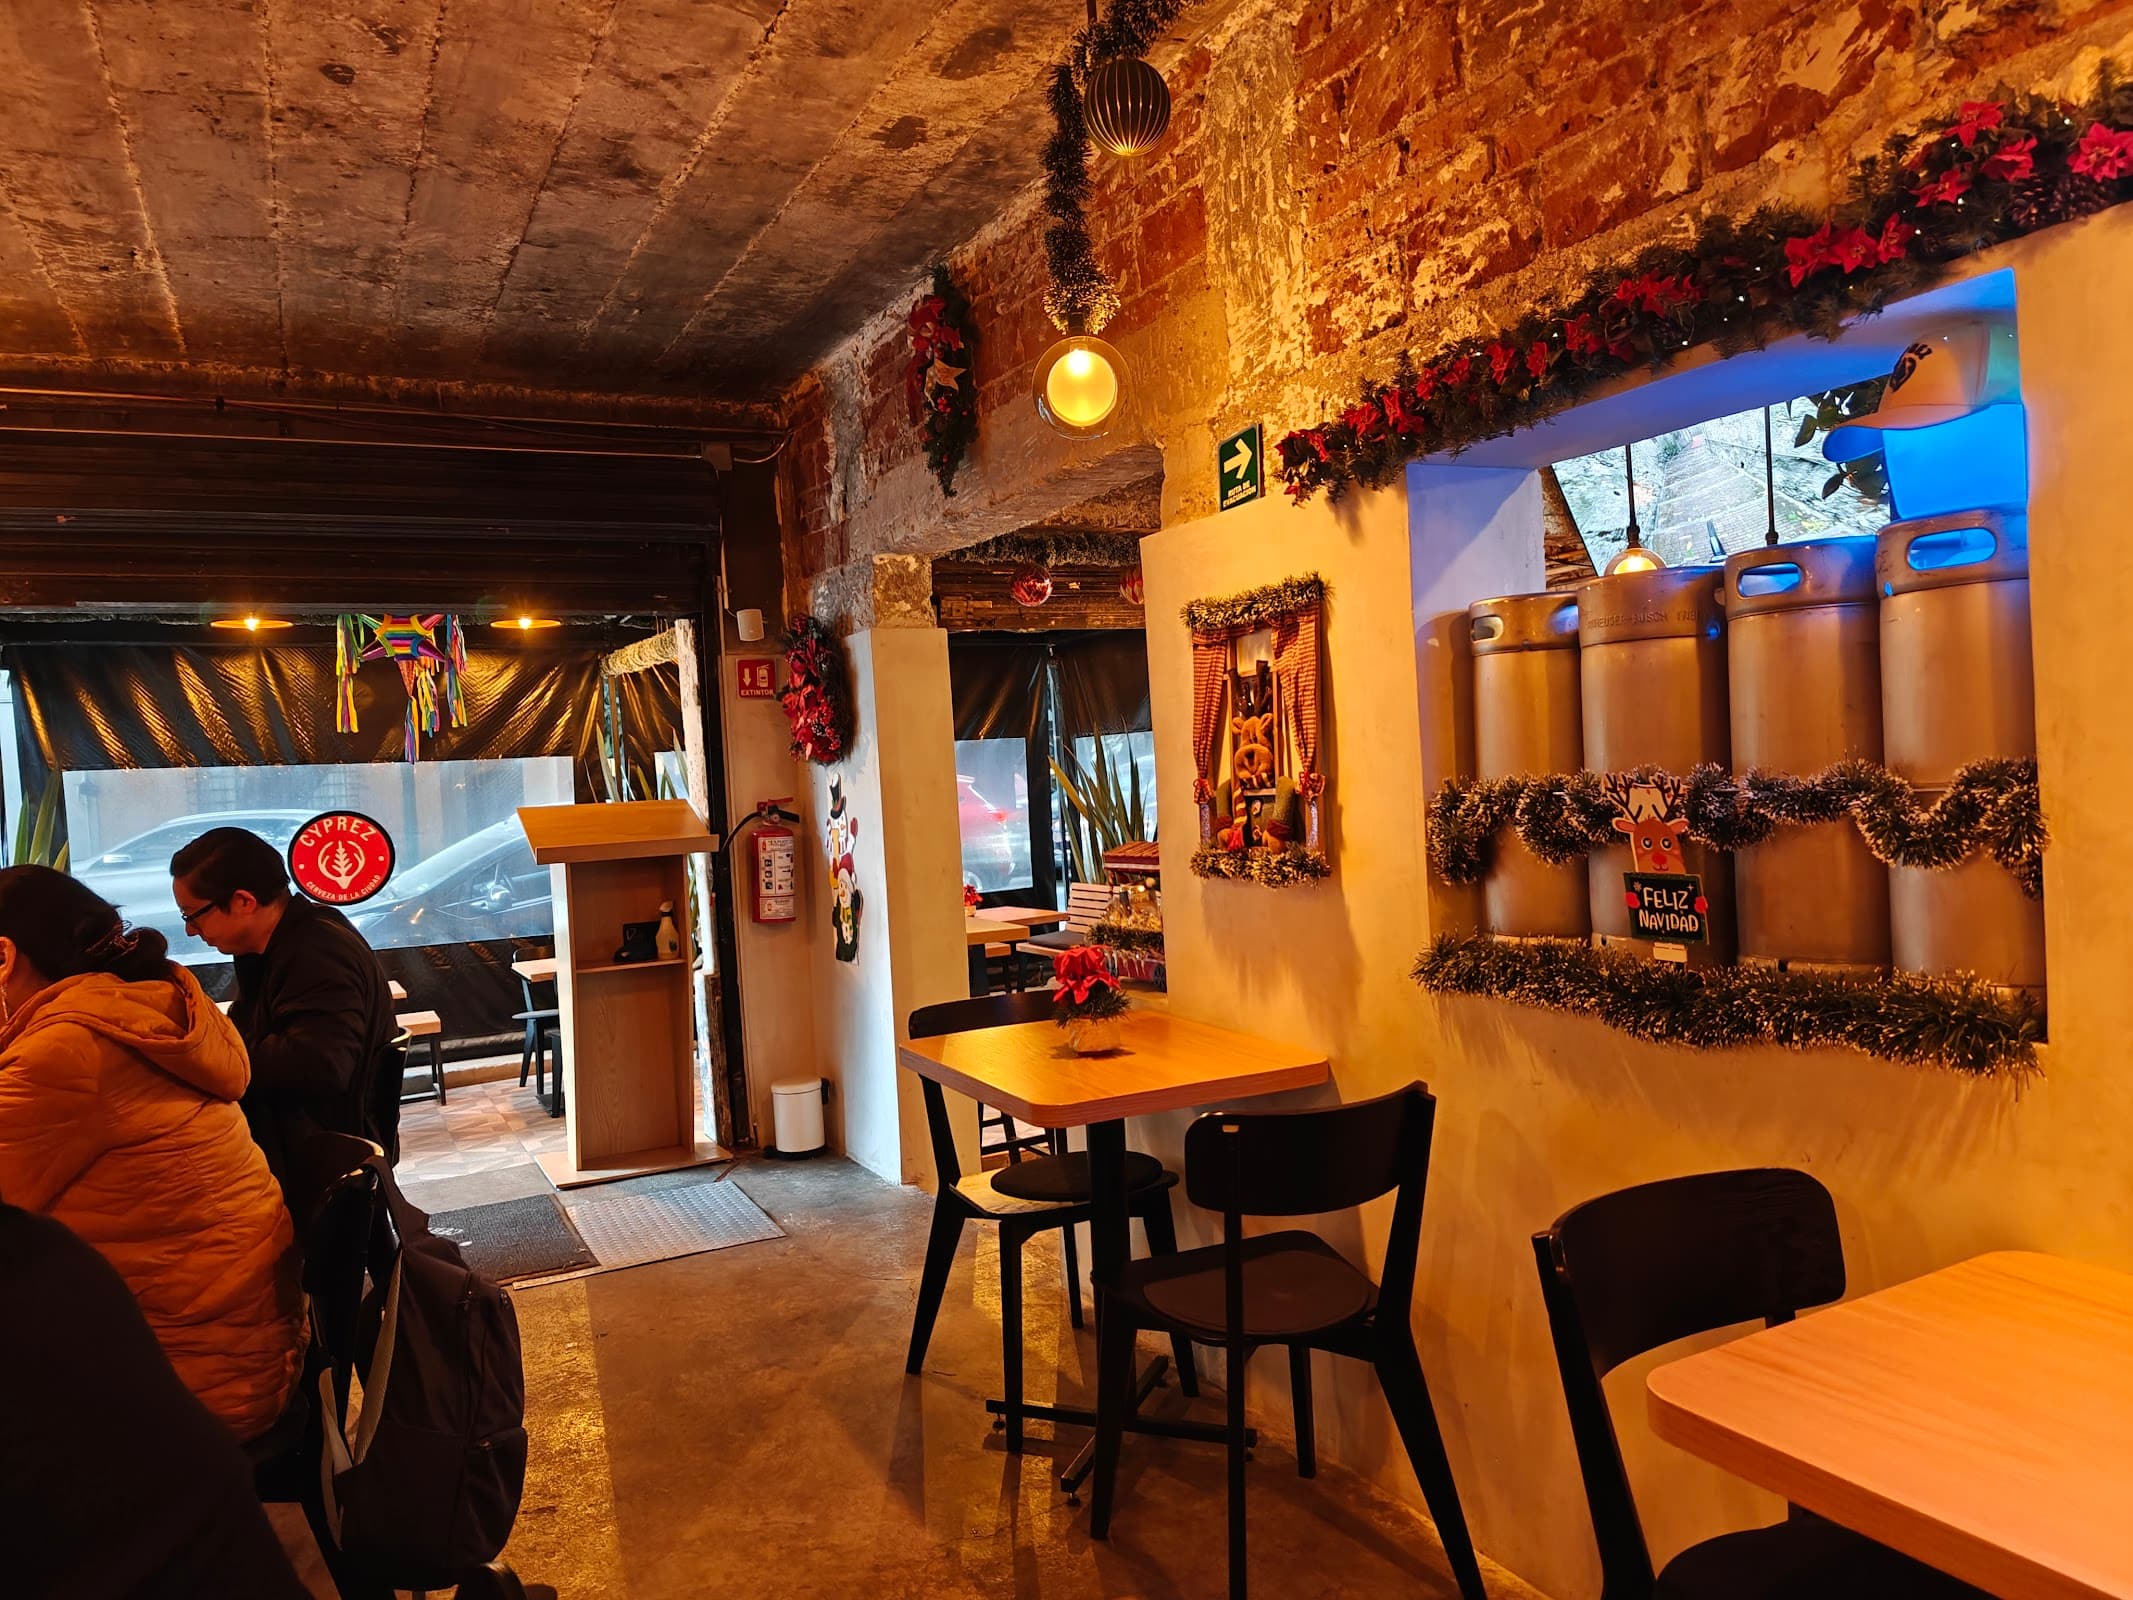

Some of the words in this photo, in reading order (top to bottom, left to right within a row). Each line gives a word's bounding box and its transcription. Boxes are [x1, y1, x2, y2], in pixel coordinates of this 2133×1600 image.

[741, 689, 775, 697] EXTINTOR
[299, 815, 377, 848] CYPREZ
[305, 881, 336, 901] CERVEZA
[350, 891, 360, 900] LA
[360, 874, 381, 896] CIUDAD
[1643, 887, 1689, 910] FELIZ
[1639, 909, 1699, 932] NAVIDAD
